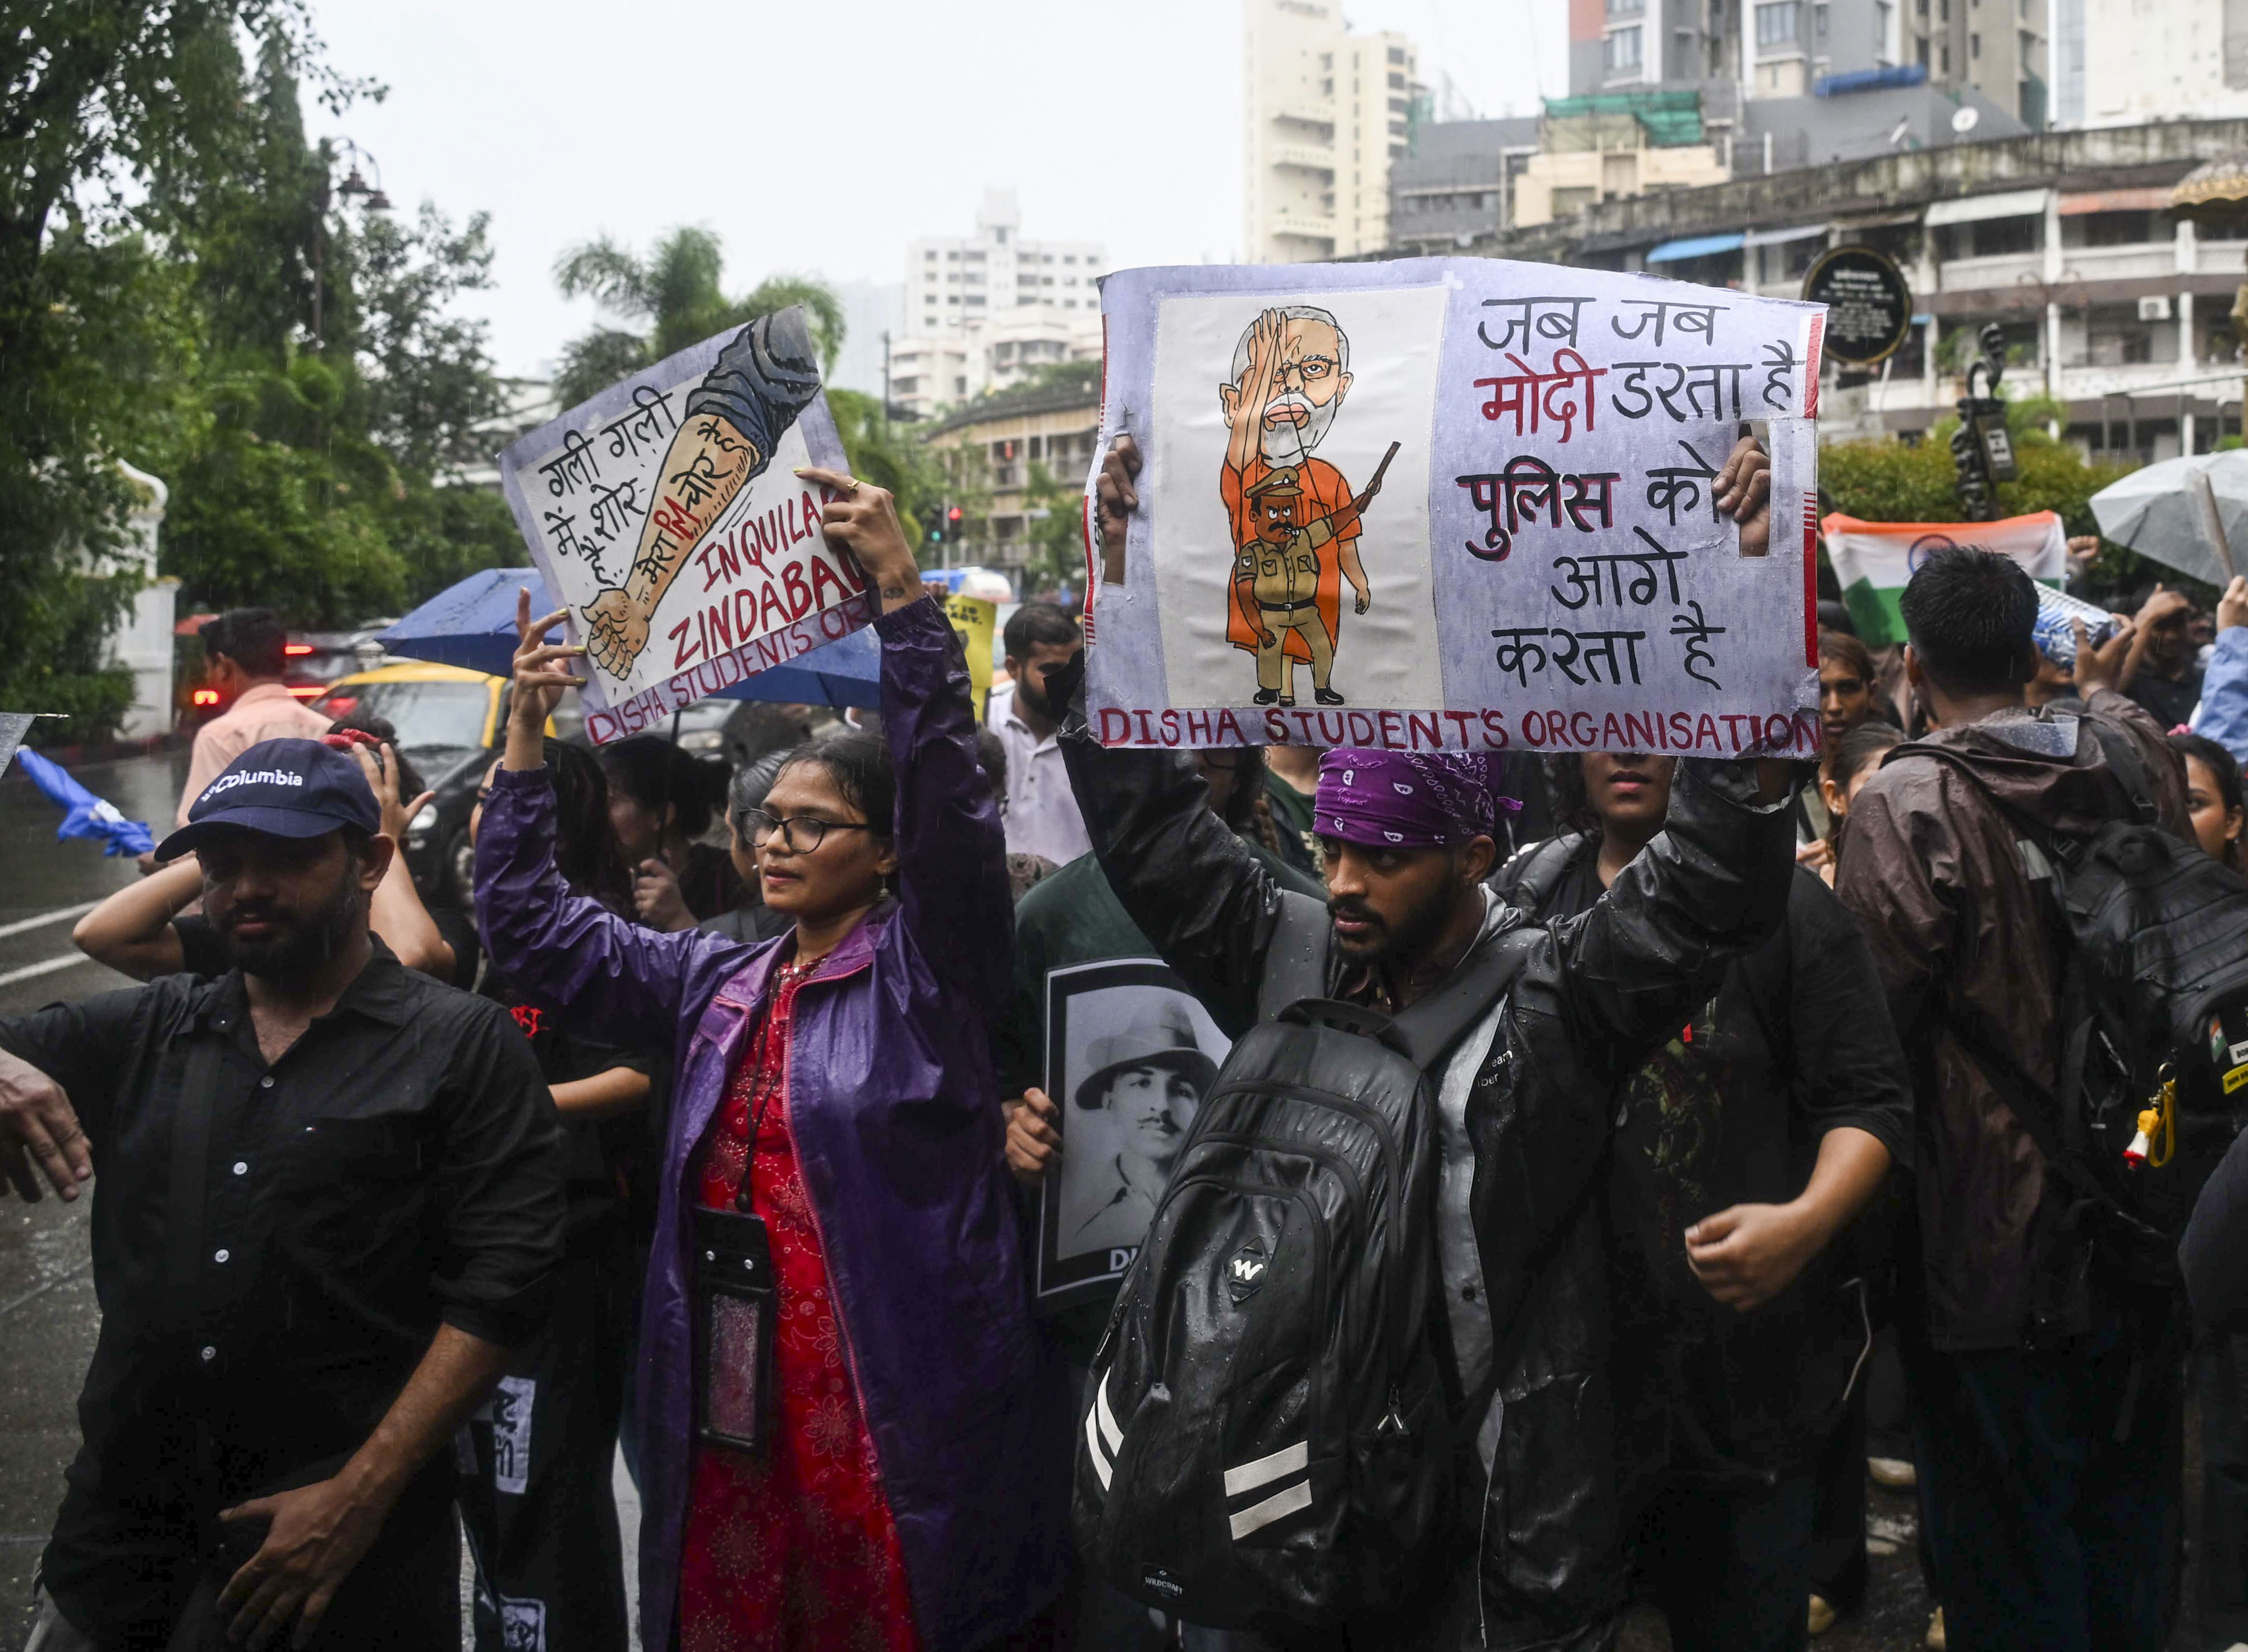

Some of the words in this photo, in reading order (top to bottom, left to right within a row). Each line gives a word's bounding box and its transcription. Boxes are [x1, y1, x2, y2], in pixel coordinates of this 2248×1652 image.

[1478, 297, 1597, 355] जब
[1612, 300, 1731, 347] जब
[1474, 348, 1608, 443] मोदी
[1612, 361, 1753, 422] डरता
[1760, 339, 1805, 410] है
[539, 430, 600, 497] गली
[600, 385, 677, 458] गली
[670, 448, 733, 512] चोर
[544, 506, 582, 556] में
[590, 477, 646, 542] शोर
[654, 495, 701, 541] PM
[1455, 455, 1621, 562] पुलिस
[1551, 526, 1689, 610] आगे
[588, 687, 668, 746] DISHA
[670, 621, 813, 707] STUDENTS
[1491, 627, 1645, 688] करता
[1670, 600, 1726, 691] है
[1098, 708, 1248, 747] DISHA
[1264, 708, 1509, 751] STUDENT'S
[1521, 710, 1823, 753] ORGANISATION
[215, 769, 303, 794] Columbia
